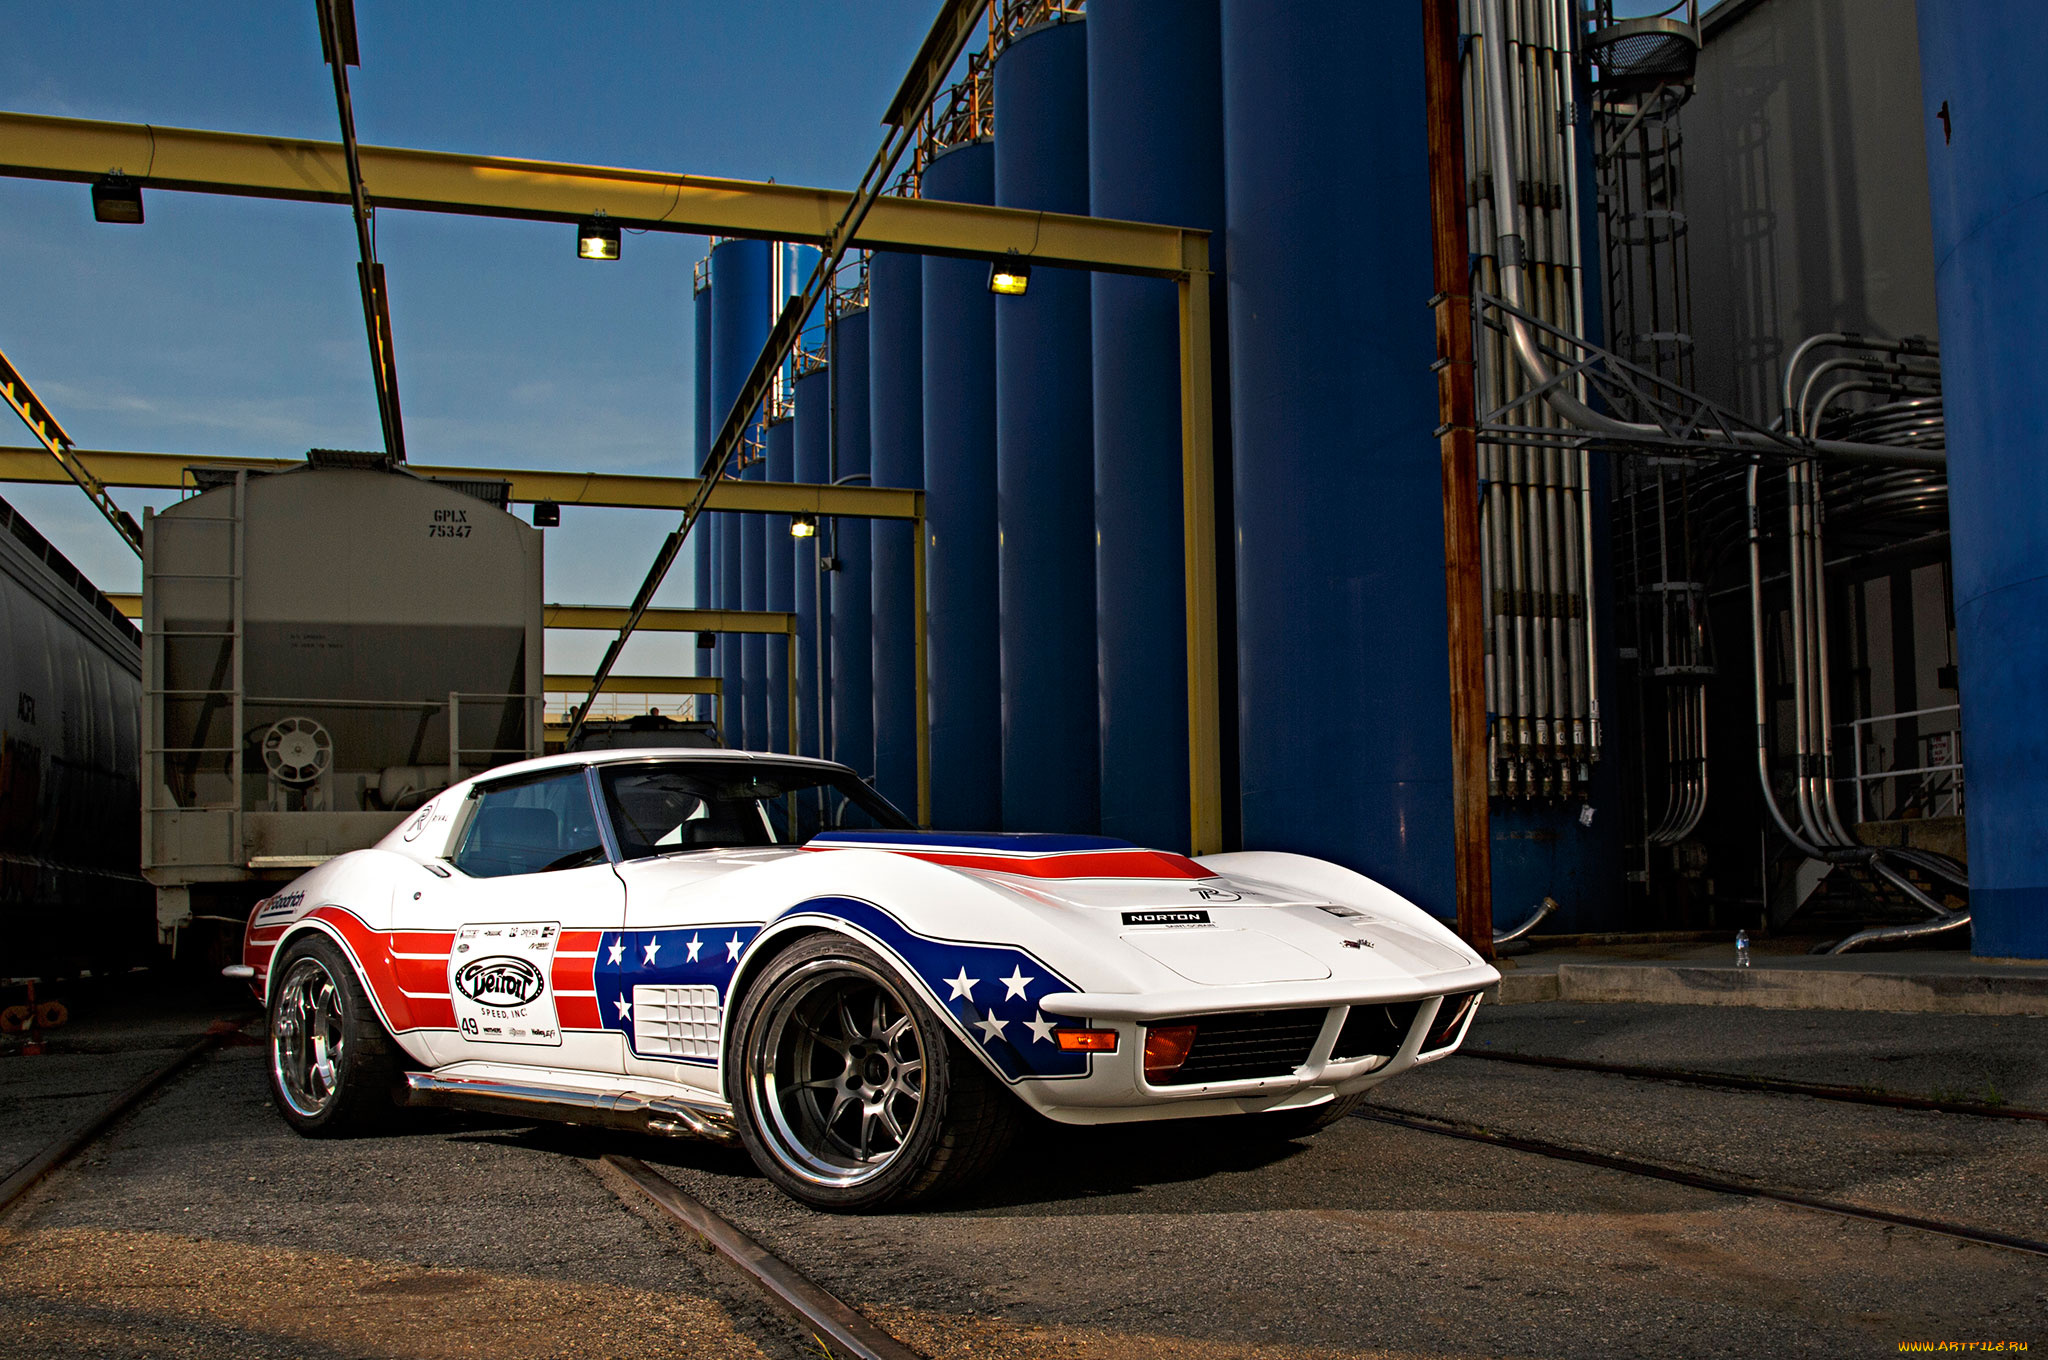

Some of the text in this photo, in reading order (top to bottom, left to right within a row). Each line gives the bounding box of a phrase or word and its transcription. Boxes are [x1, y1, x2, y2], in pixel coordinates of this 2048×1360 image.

[434, 509, 467, 523] GPLX
[429, 525, 472, 538] 75347
[1130, 913, 1201, 922] NORTON
[481, 1008, 509, 1019] SPEED,
[461, 1017, 479, 1036] 49
